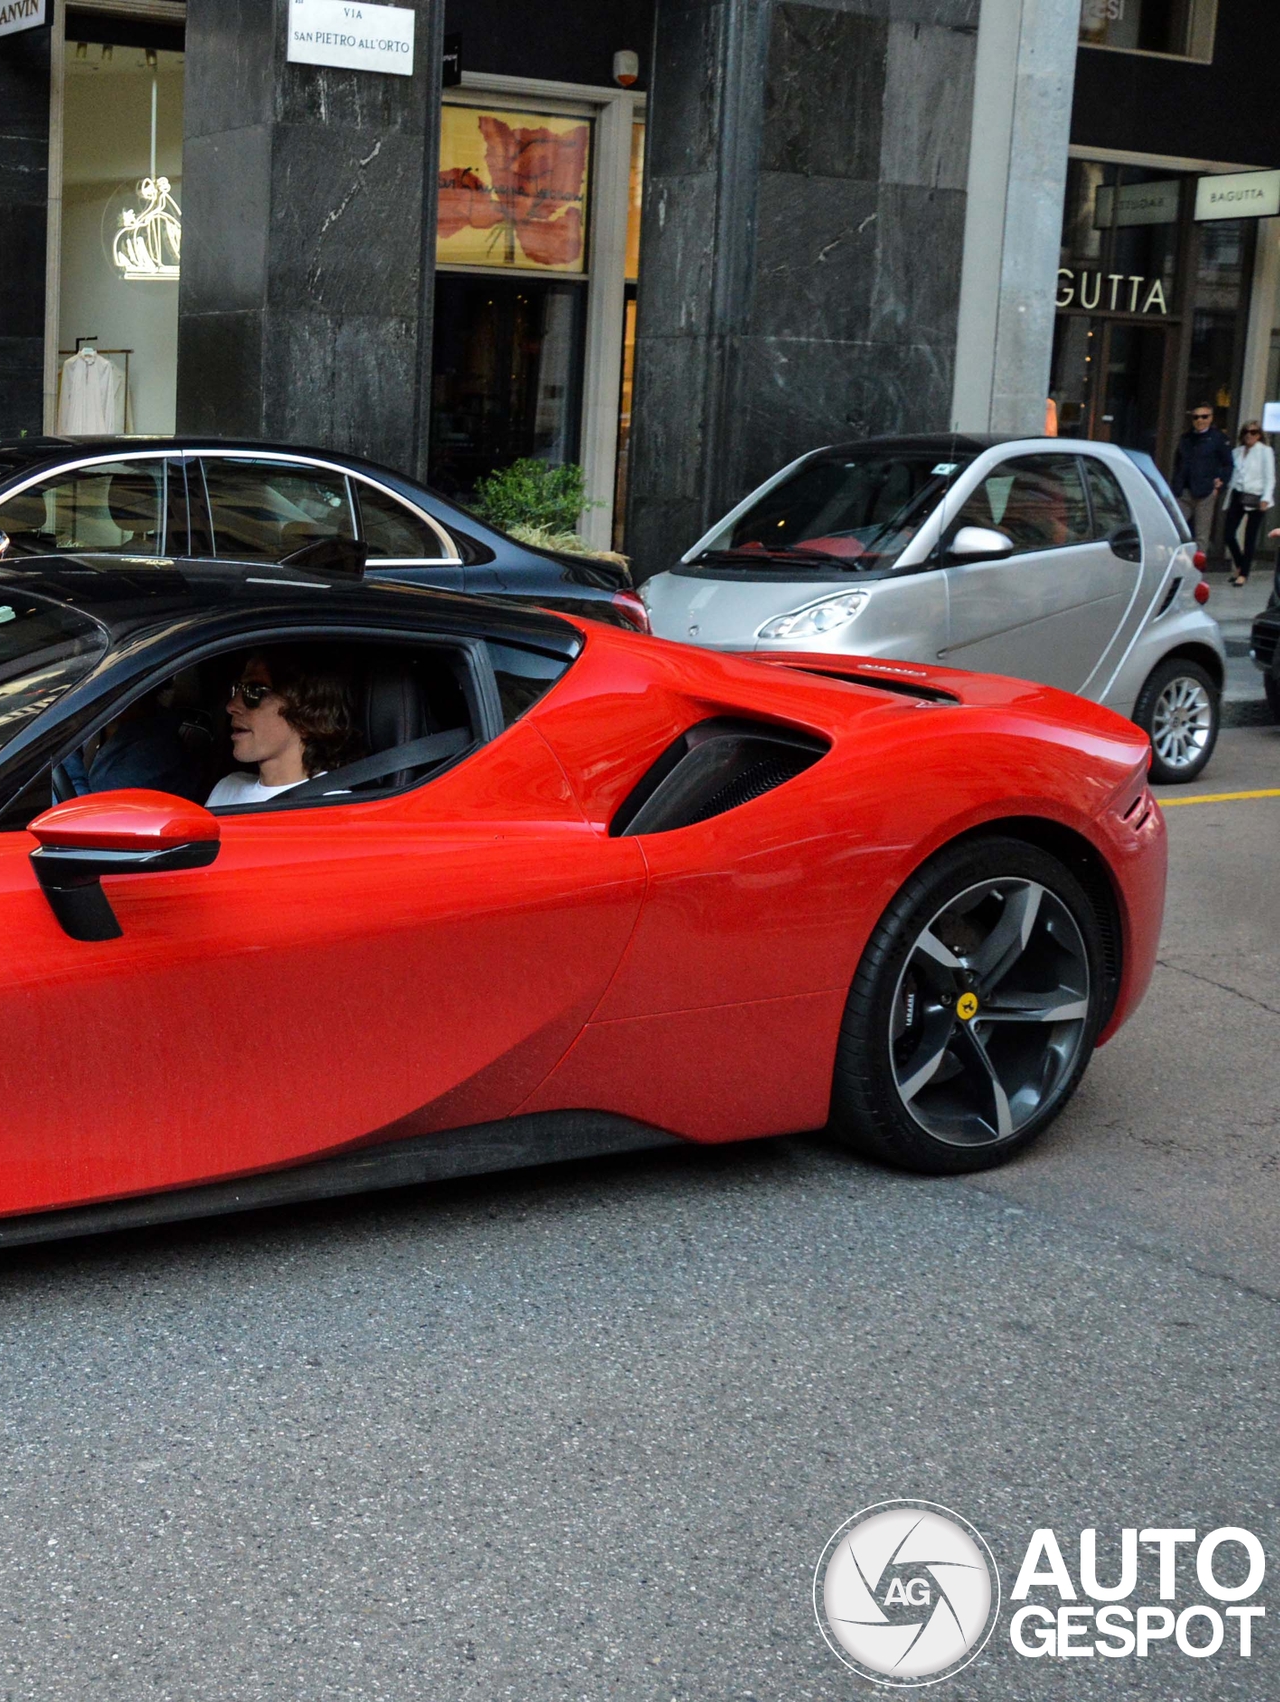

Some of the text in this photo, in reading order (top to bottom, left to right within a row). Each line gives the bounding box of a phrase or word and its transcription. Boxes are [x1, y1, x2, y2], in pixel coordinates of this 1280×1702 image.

[343, 7, 363, 19] VIA
[294, 31, 410, 53] SAN PIETRO ALL'ORTO
[1210, 188, 1264, 203] BAGUTTA
[1054, 268, 1167, 314] GUTTA
